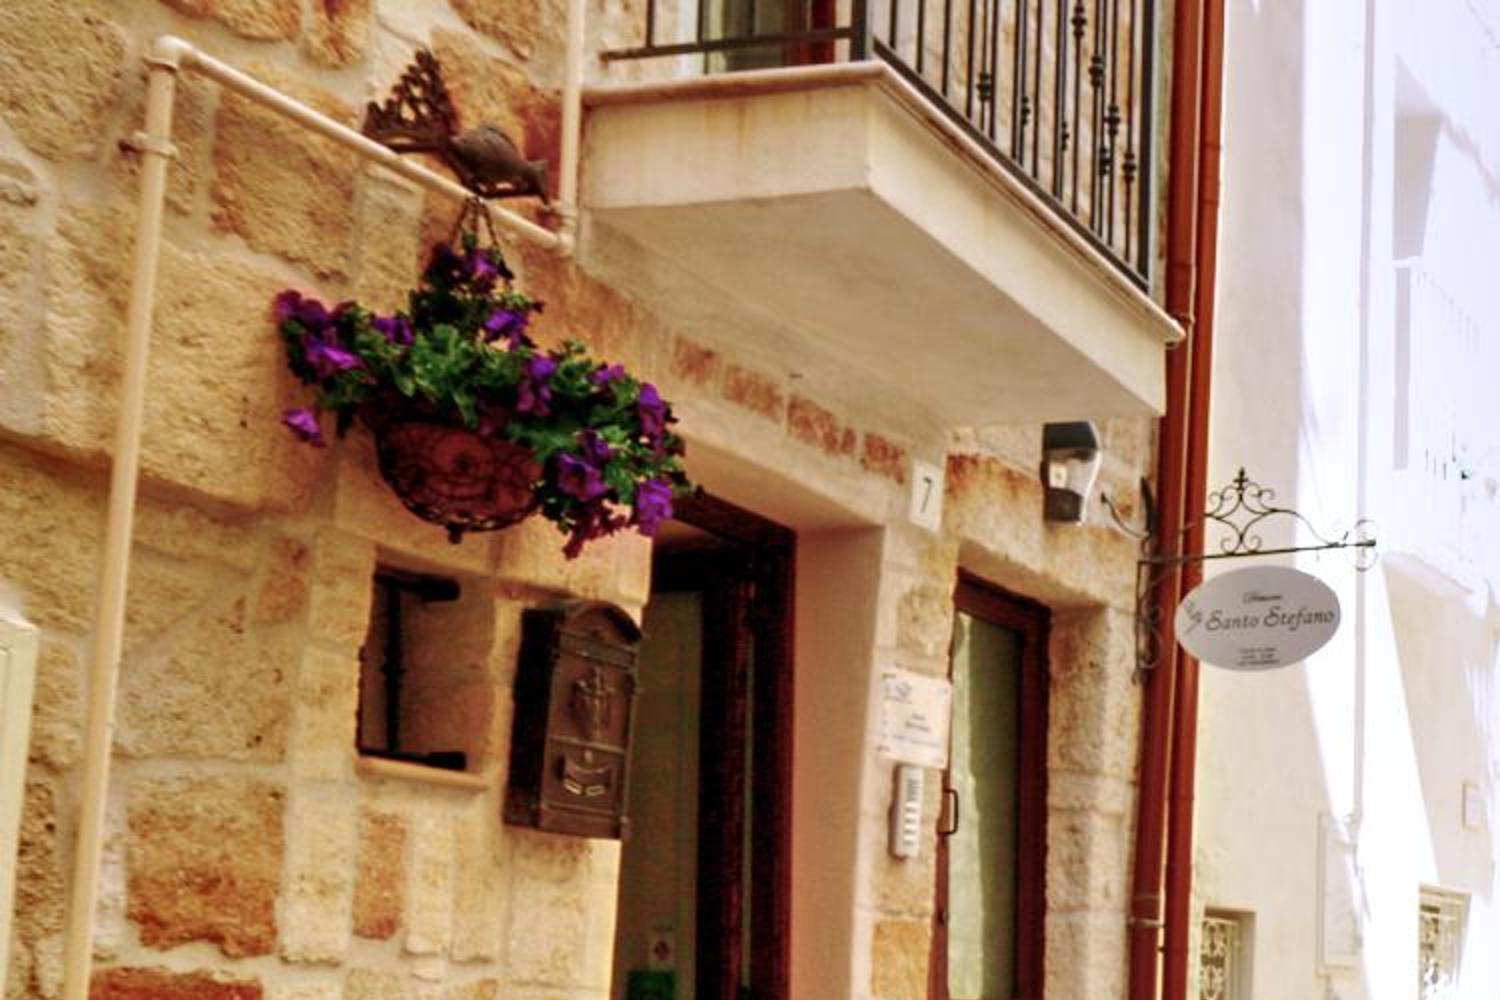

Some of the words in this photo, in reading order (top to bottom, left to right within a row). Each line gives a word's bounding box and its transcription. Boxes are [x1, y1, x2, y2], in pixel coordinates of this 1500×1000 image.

[920, 475, 934, 515] 7
[1205, 609, 1259, 631] Santo
[1262, 605, 1336, 632] Stefano
